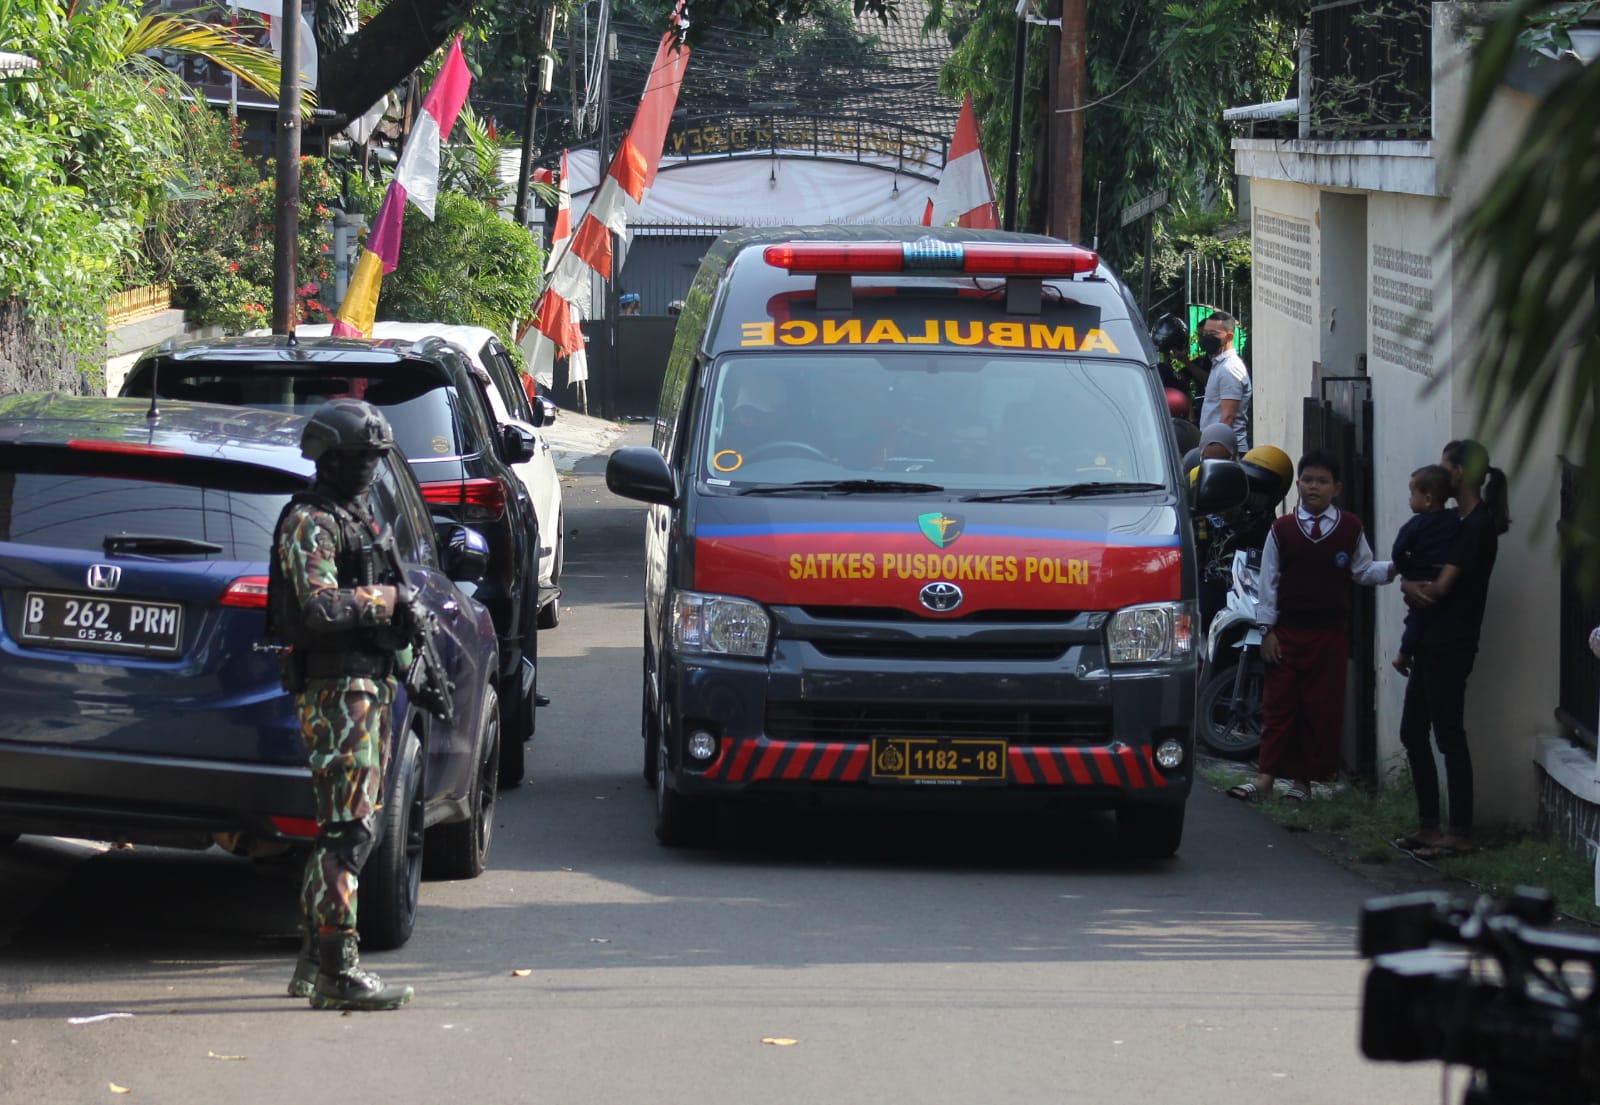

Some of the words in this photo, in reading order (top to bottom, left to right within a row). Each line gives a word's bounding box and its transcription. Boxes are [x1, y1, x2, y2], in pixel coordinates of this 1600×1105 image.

[789, 553, 875, 580] SATKES
[883, 553, 1018, 582] PUSDOKKES
[1025, 556, 1089, 584] POLRI
[29, 597, 45, 623] B
[64, 601, 110, 629] 262
[129, 605, 176, 635] PRM
